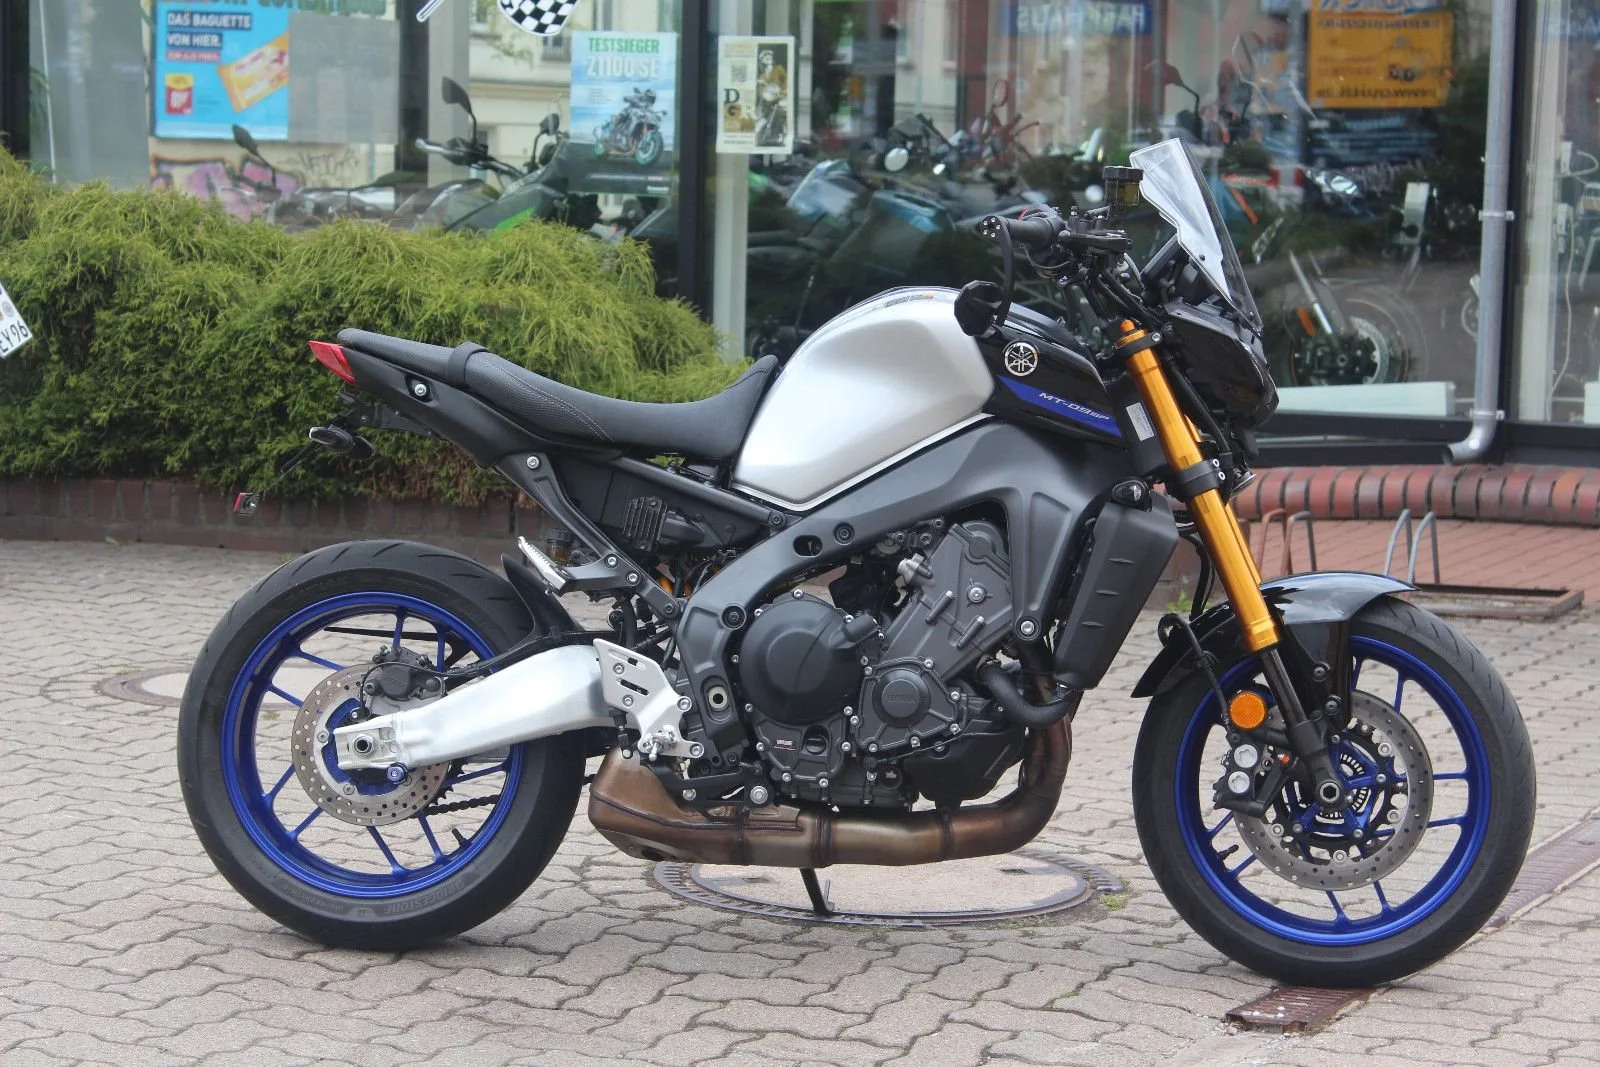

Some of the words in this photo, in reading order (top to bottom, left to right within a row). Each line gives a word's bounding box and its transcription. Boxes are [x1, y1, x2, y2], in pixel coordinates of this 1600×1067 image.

[167, 12, 190, 26] DAS
[192, 13, 251, 28] BAGUETTE
[167, 33, 190, 46] VON
[588, 37, 660, 54] TESTSIEGER
[587, 55, 635, 77] Z1100
[639, 56, 660, 78] SE
